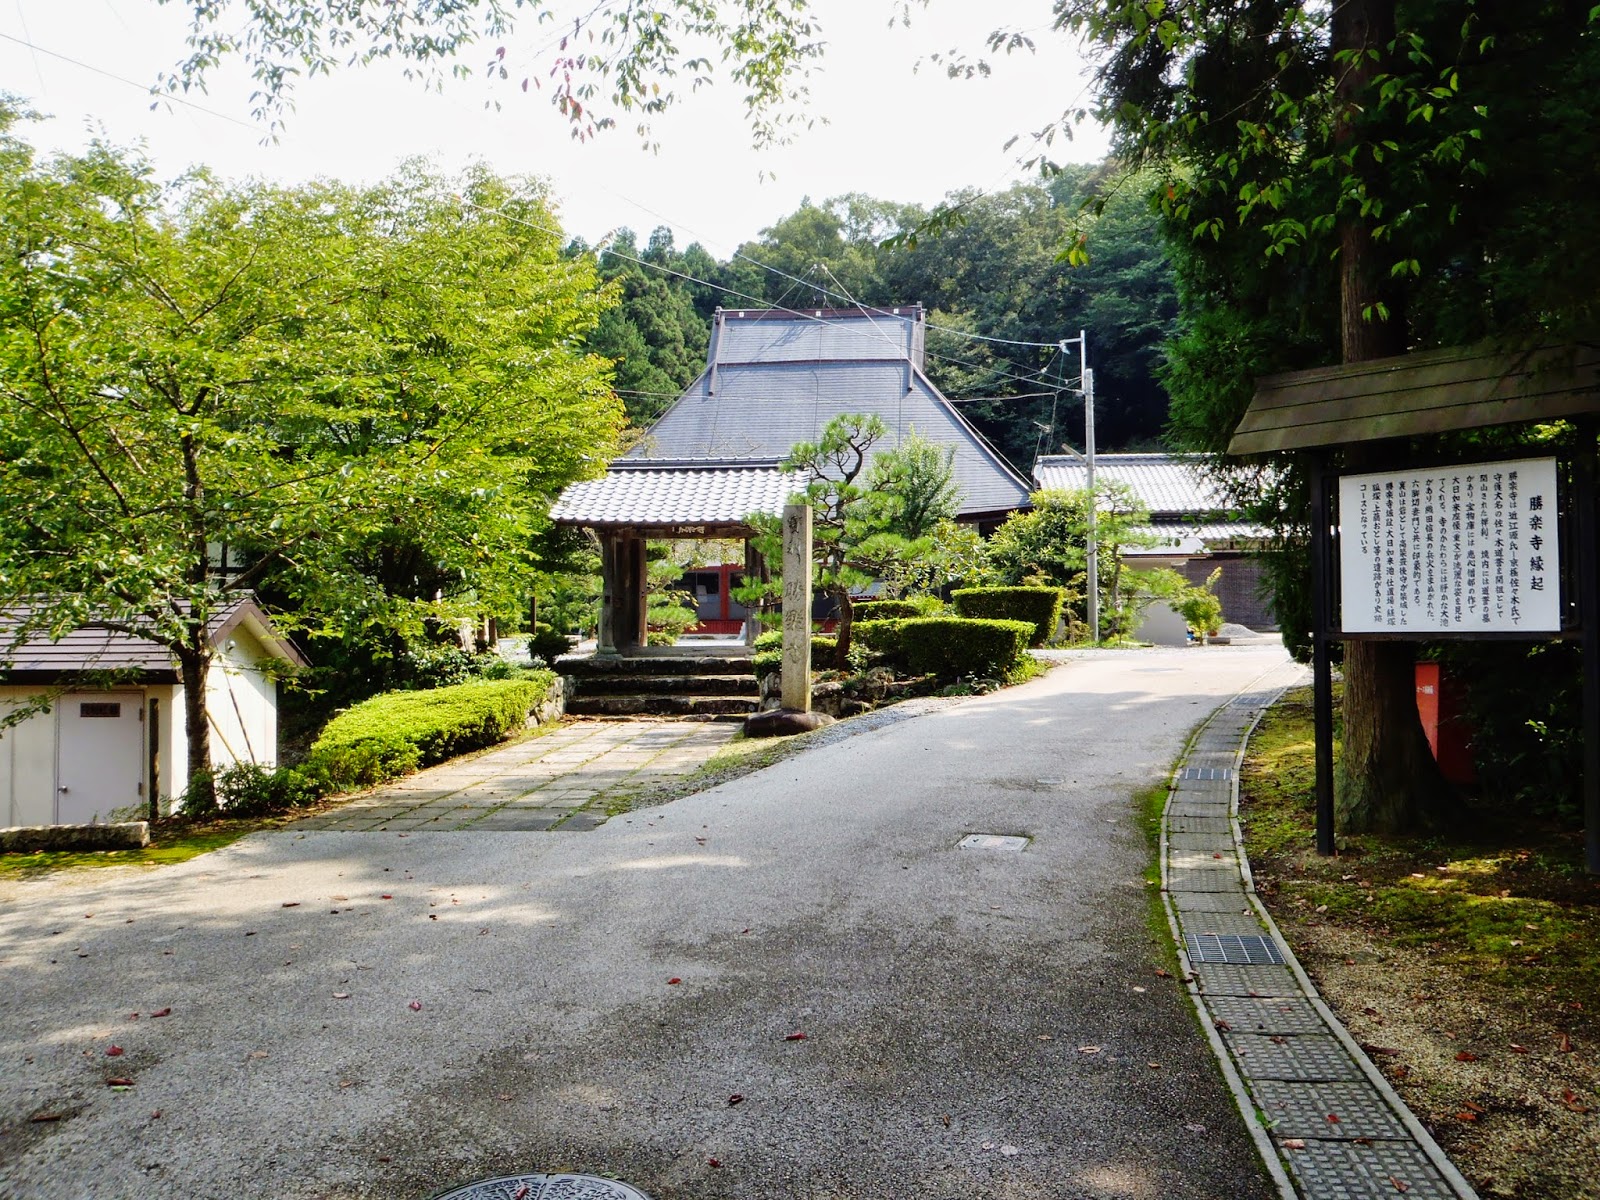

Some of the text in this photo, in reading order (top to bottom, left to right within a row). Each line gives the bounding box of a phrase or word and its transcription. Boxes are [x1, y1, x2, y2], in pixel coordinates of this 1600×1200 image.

[1359, 484, 1370, 554] コースとなっている
[1528, 495, 1545, 591] 勝楽寺縁起
